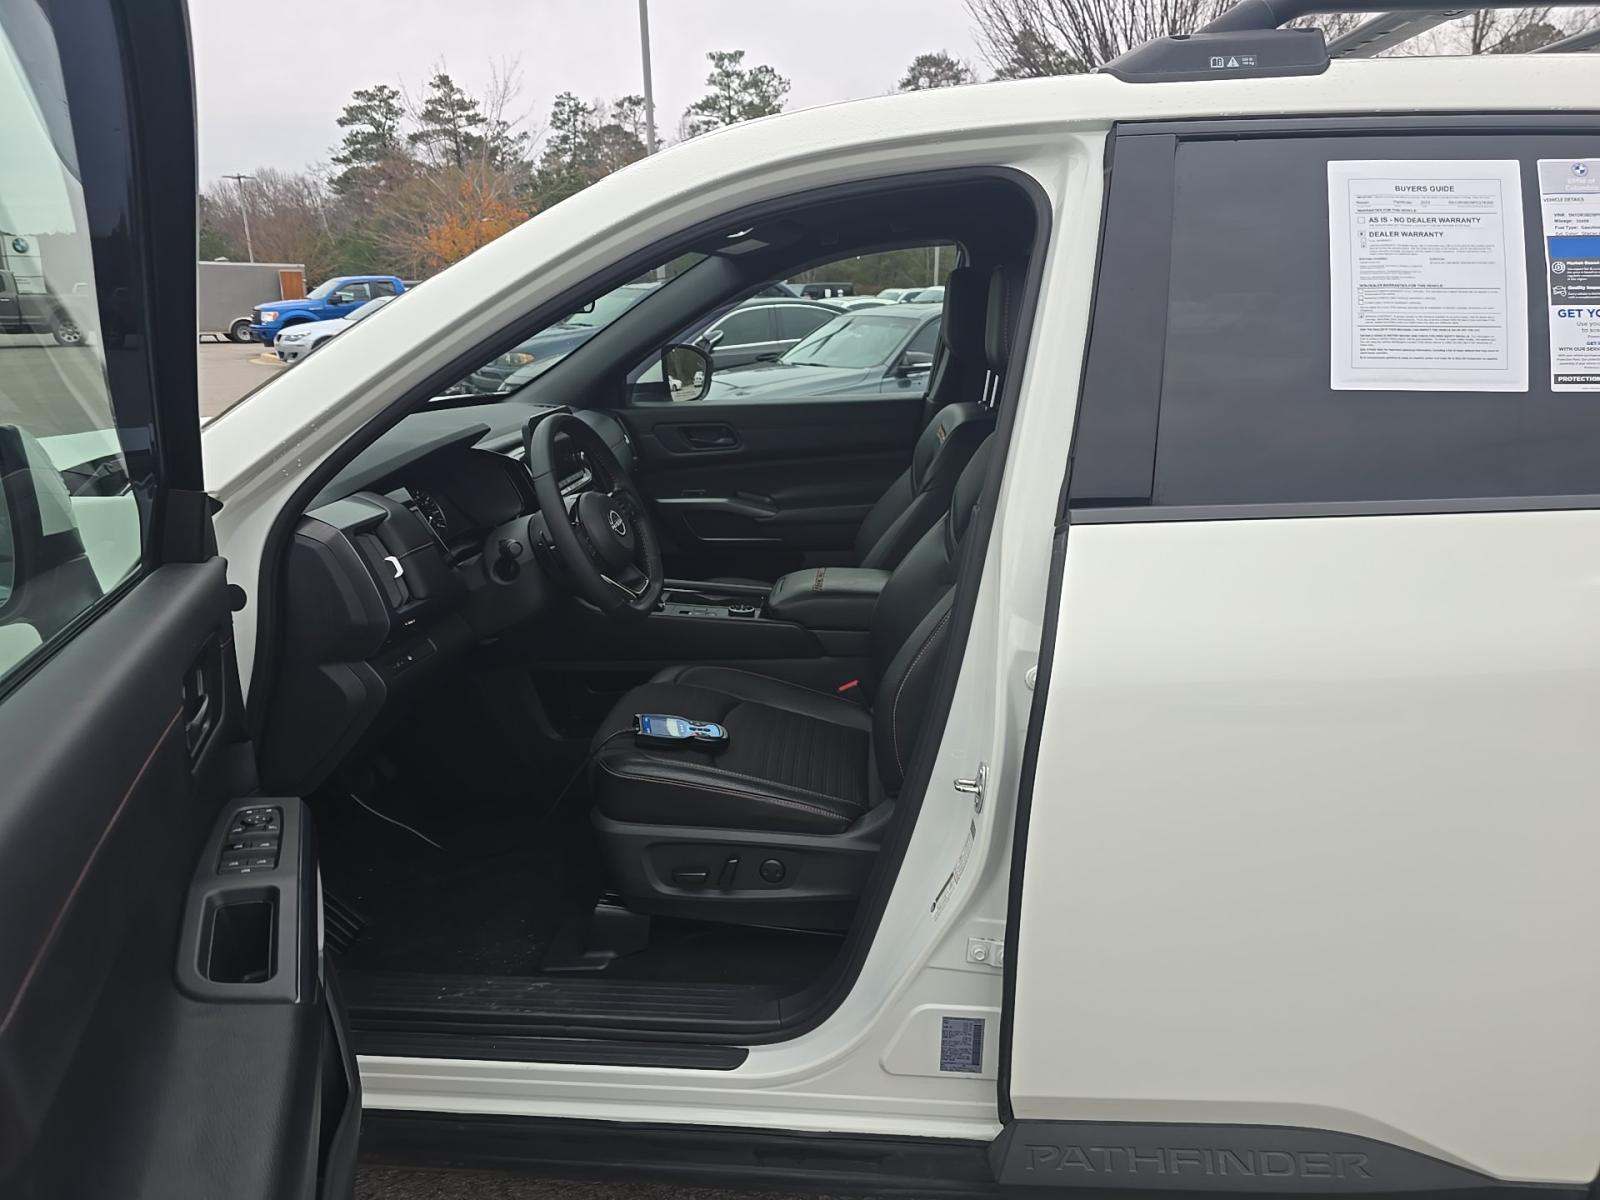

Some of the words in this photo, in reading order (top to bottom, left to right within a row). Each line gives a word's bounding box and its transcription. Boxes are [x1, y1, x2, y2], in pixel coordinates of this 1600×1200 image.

[1395, 185, 1428, 193] BUYERS
[1429, 185, 1455, 193] GUIDE
[1558, 309, 1583, 318] GET
[1024, 1144, 1374, 1179] PATHFINDER
